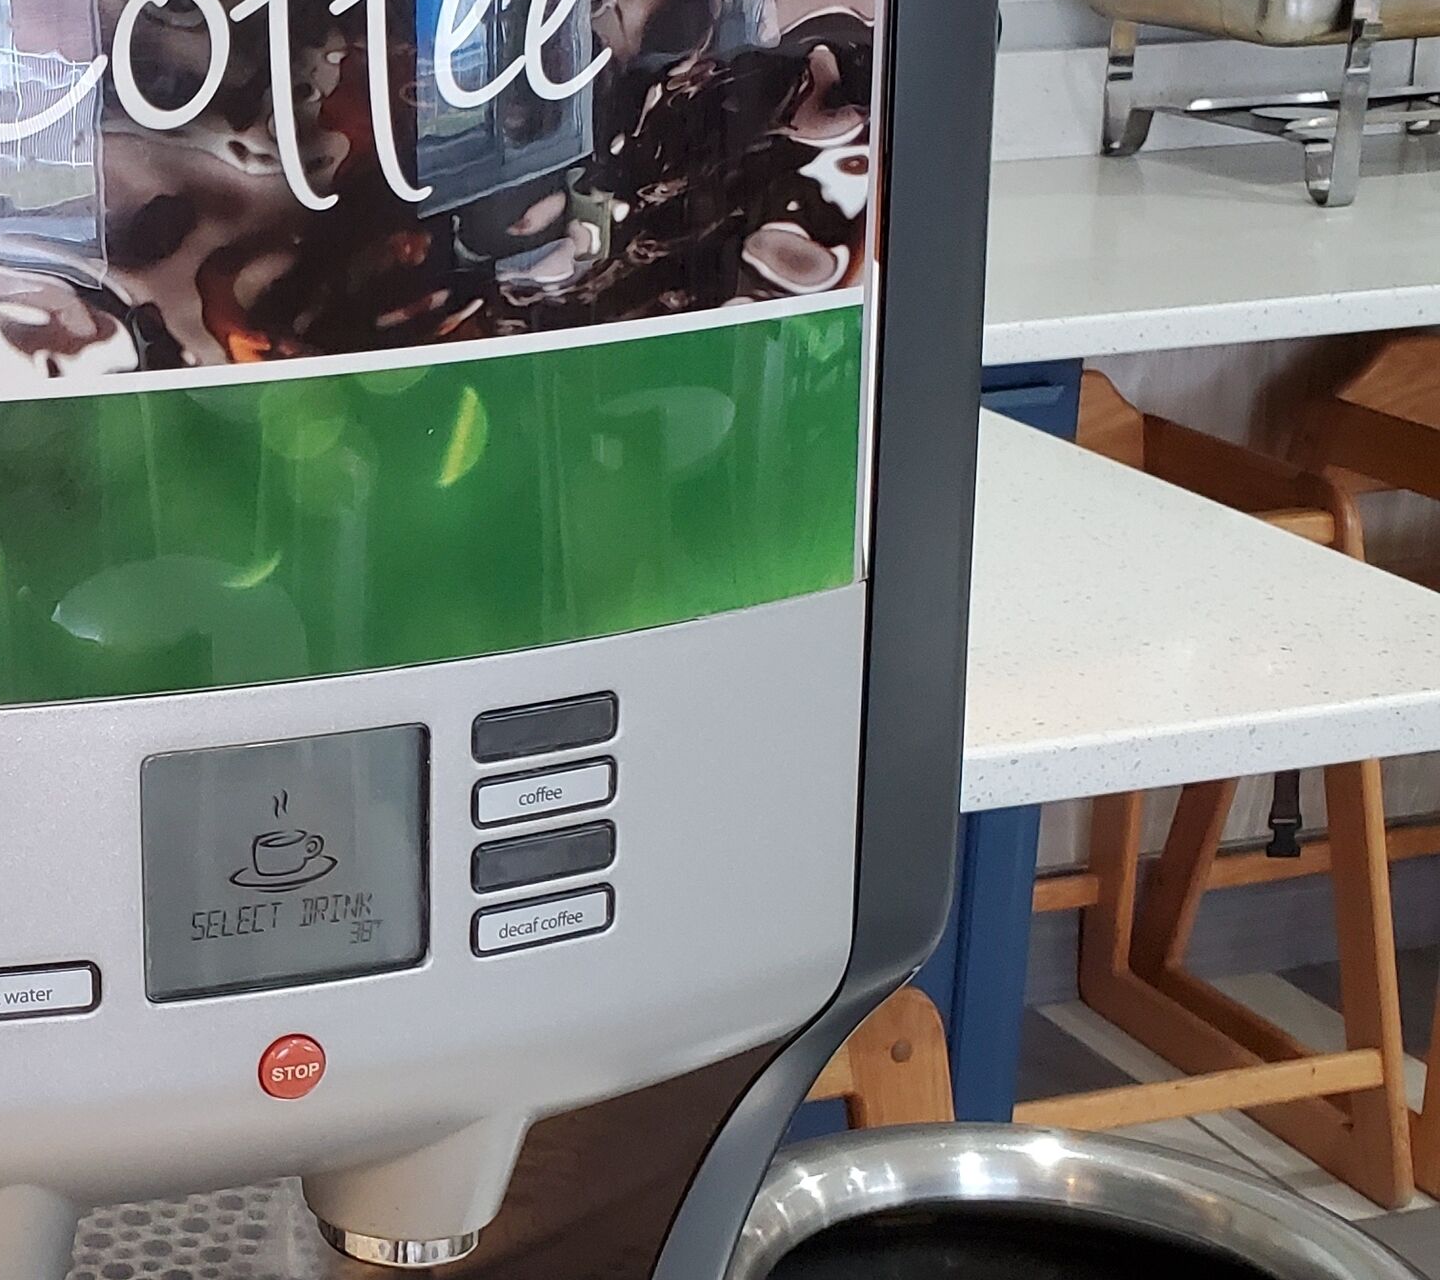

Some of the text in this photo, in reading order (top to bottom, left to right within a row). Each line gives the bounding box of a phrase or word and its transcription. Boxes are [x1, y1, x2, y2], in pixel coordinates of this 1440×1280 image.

[518, 786, 563, 806] coffee
[191, 893, 373, 941] SELECT DRINK
[498, 910, 583, 940] decaf coffee
[4, 987, 53, 1005] water
[271, 1062, 320, 1082] STOP
